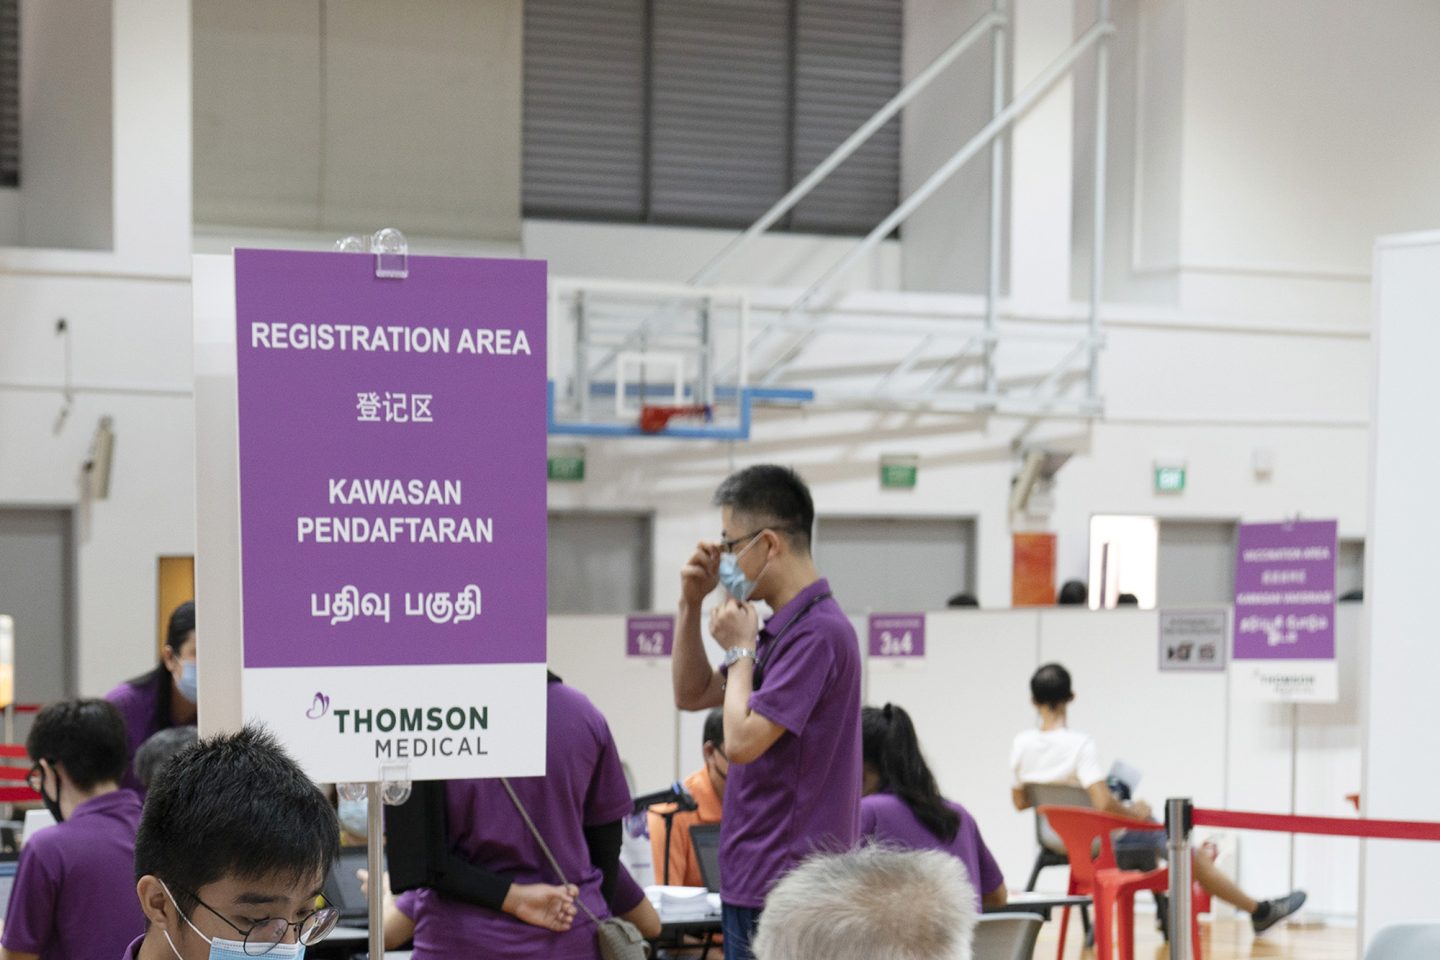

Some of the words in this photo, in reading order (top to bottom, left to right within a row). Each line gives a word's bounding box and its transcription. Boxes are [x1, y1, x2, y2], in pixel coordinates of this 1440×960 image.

[251, 322, 450, 354] REGISTRATION
[457, 328, 532, 355] AREA
[356, 391, 434, 423] 登记区
[328, 478, 462, 505] KAWASAN
[297, 516, 494, 544] PENDAFTARAN
[310, 584, 391, 626] பதிவு
[404, 584, 483, 625] பகுதி
[333, 705, 489, 735] THOMSON
[374, 736, 488, 759] MEDICAL
